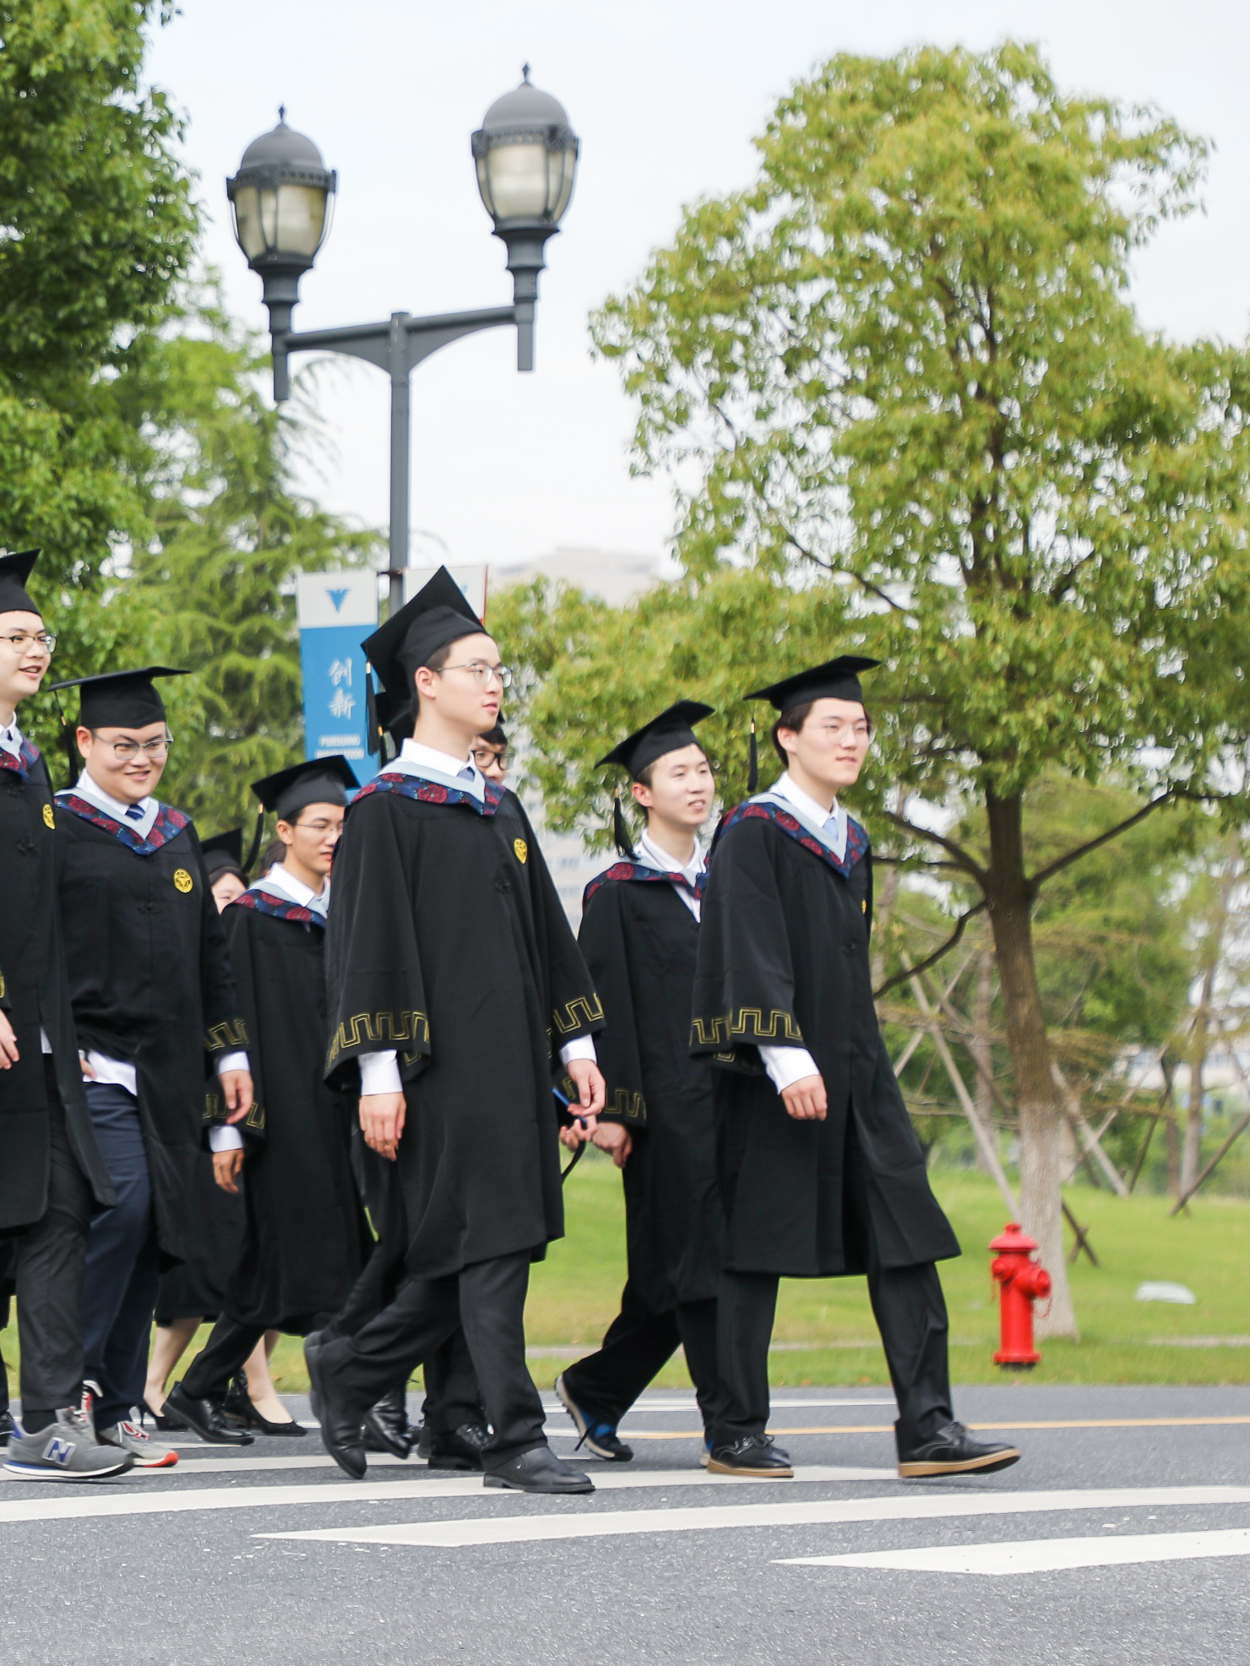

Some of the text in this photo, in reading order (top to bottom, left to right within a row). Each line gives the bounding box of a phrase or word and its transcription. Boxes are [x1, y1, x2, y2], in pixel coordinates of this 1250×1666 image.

[328, 657, 356, 719] 创新
[319, 734, 361, 747] PURSUING
[42, 1436, 77, 1466] N
